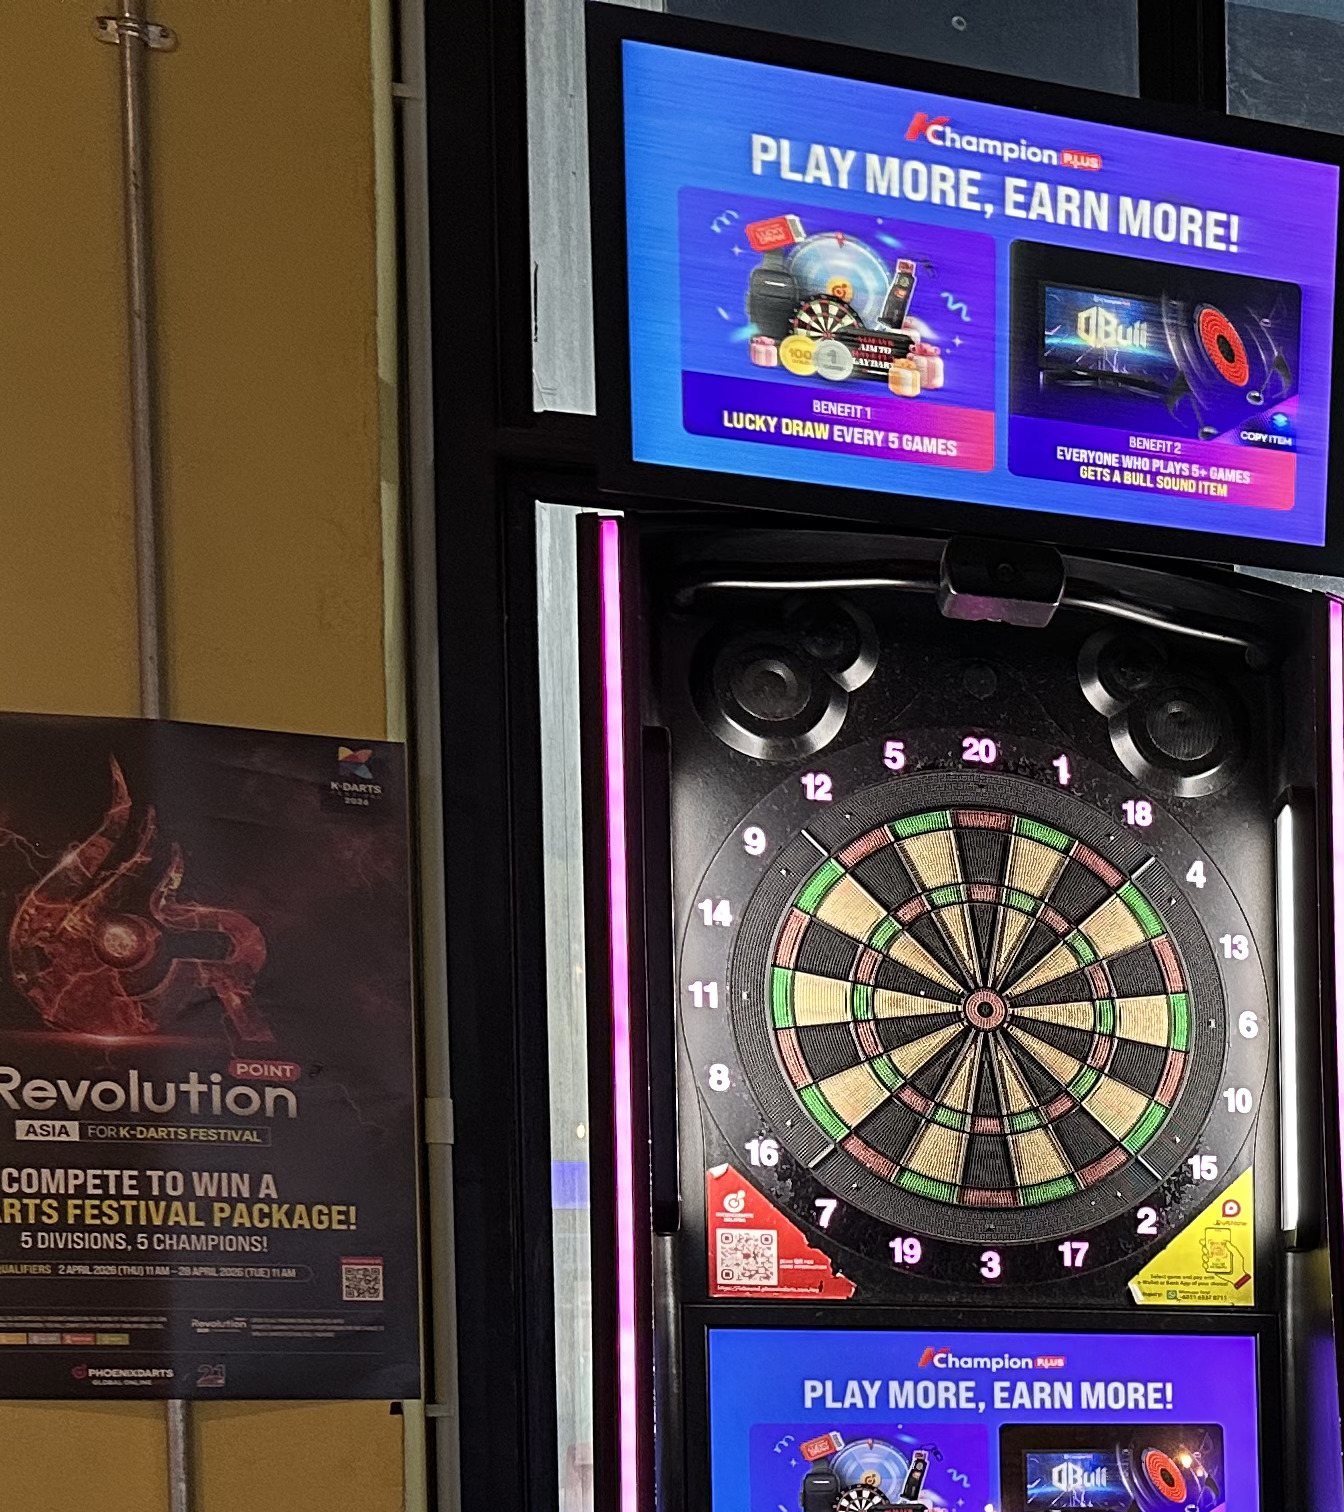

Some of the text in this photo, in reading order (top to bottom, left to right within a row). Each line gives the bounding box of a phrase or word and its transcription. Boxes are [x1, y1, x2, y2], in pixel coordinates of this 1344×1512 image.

[753, 134, 1242, 253] PLAY MORE, EARN MORE!
[813, 399, 872, 419] BENEFIT 1
[724, 410, 957, 457] LUCKY DRAW EVERY 5 GAMES
[885, 741, 907, 770] 5
[963, 738, 997, 764] 20
[803, 774, 834, 801] 12
[235, 1063, 294, 1078] POINT
[0, 1066, 298, 1117] Revolution
[25, 1123, 261, 1142] ASIA FOR K-DARTS FESTIVAL
[1, 1167, 278, 1199] COMPETE TO WIN A
[0, 1199, 357, 1230] RTS FESTIVAL PACKAGE!
[21, 1232, 268, 1252] 5 DIVISIONS, 5 CHAMPIONS!
[1058, 1241, 1090, 1268] 17
[980, 1251, 1001, 1279] 3
